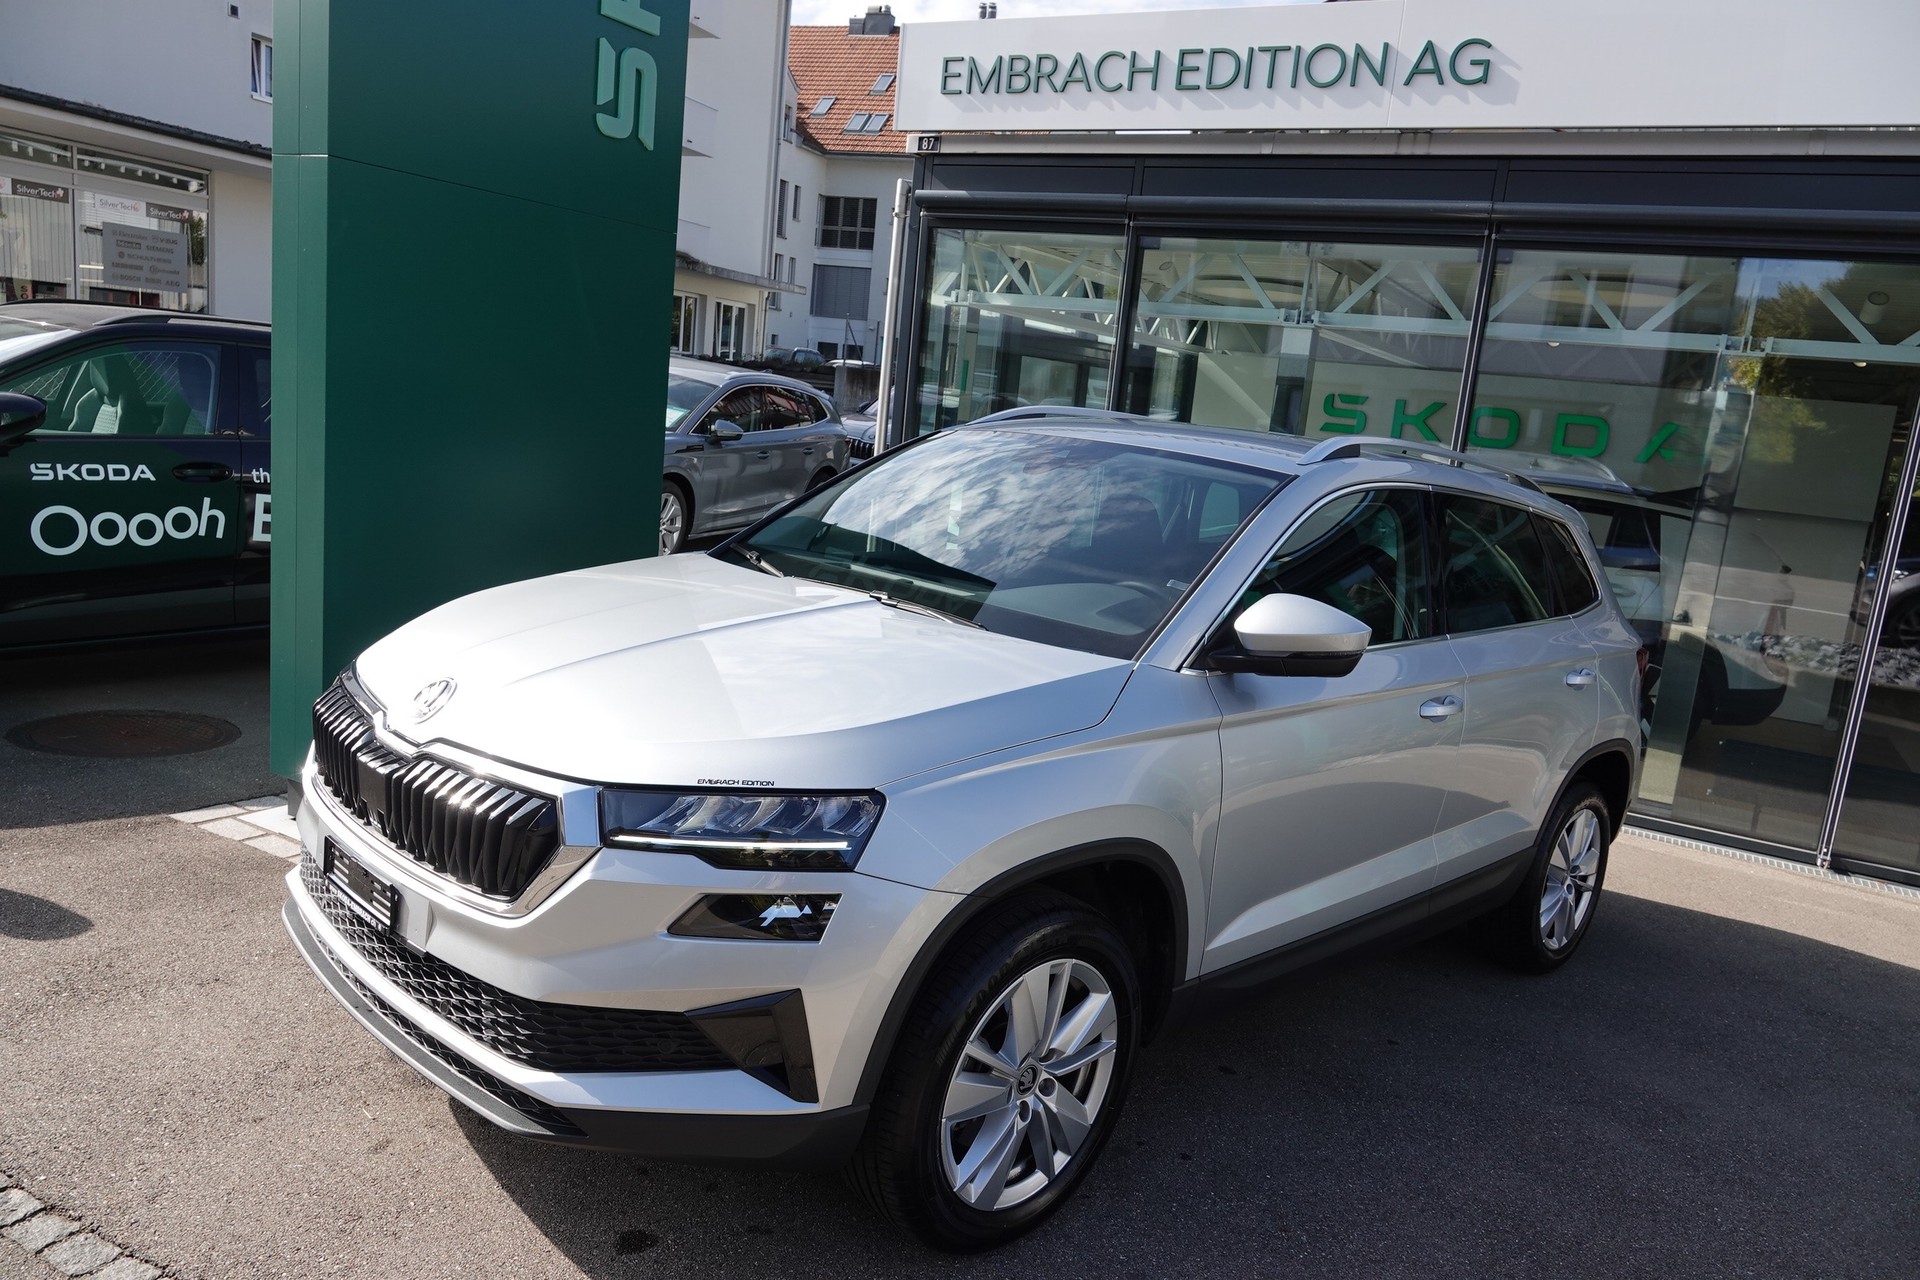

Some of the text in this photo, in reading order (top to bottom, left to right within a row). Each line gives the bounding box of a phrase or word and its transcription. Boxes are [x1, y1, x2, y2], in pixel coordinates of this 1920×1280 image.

[940, 38, 1492, 95] EMBRACH EDITION AG
[922, 137, 935, 150] 87
[16, 184, 57, 199] SilverTech
[99, 198, 136, 212] SilverTech
[150, 207, 183, 219] SilverTech
[30, 497, 226, 556] Ooooh
